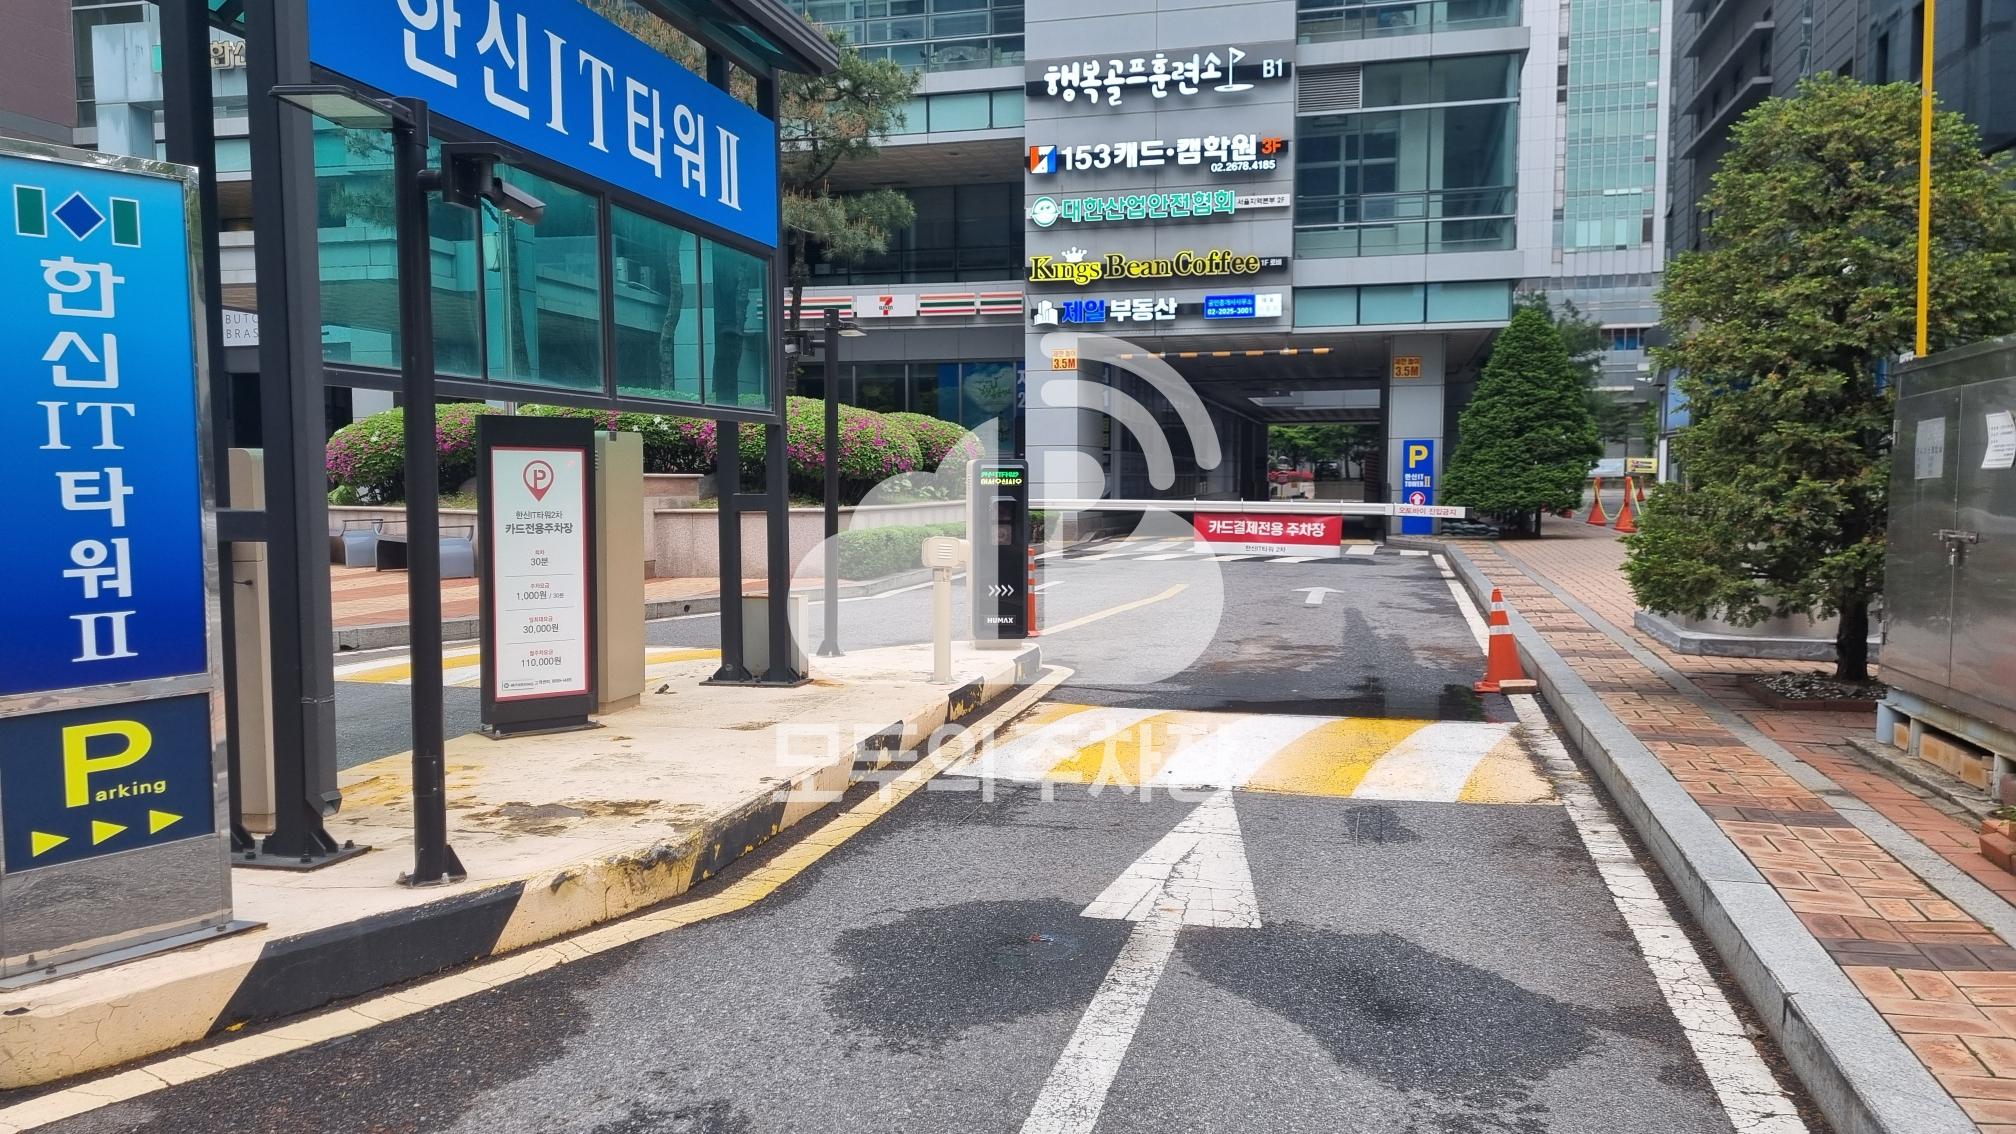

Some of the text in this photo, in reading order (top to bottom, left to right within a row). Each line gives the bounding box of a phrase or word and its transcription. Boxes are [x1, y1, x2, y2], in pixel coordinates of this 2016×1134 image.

[1044, 53, 1283, 106] 행복골프훈련소 B1
[1261, 137, 1282, 155] 3F
[1210, 159, 1276, 173] 02.2678.4185
[1061, 190, 1236, 223] 대한산업안전협회
[1029, 255, 1102, 285] Kings
[1104, 252, 1173, 279] Bean
[1173, 250, 1260, 276] Coffee
[1261, 258, 1269, 267] 1F
[1061, 297, 1178, 323] 제일 부동산
[1053, 358, 1076, 369] 3.5M
[1395, 366, 1419, 377] 3.5M
[1409, 445, 1428, 469] P
[515, 510, 563, 520] 한신IT타워2차
[1398, 506, 1457, 516] 오토바이 진입금지
[505, 522, 573, 535] 카드전용주차장
[1208, 520, 1326, 538] 카드결제전용 주차장
[530, 557, 549, 567] 30분
[516, 590, 547, 601] 1,000원
[522, 623, 559, 634] 30,000원
[521, 656, 562, 668] 110,000원
